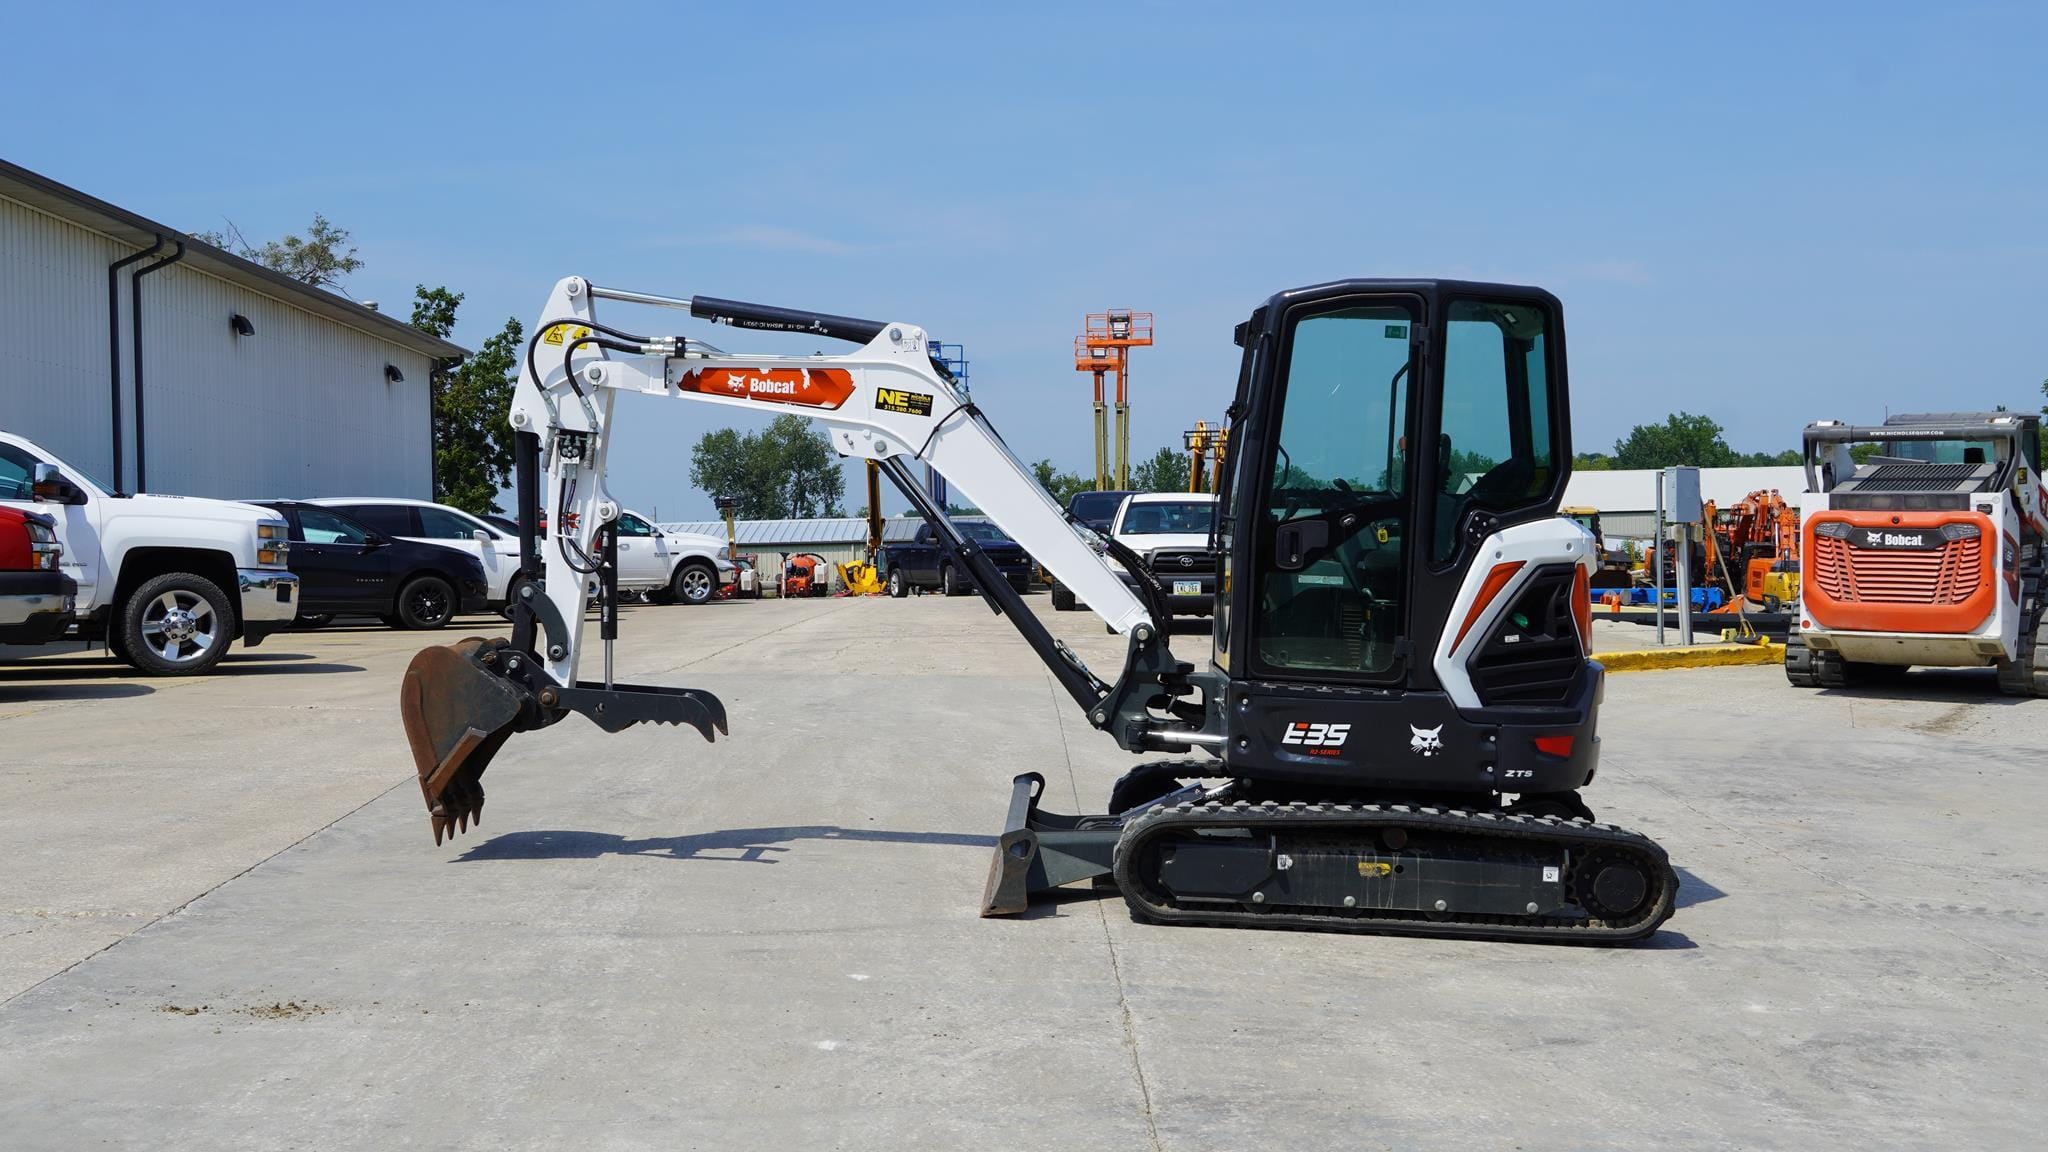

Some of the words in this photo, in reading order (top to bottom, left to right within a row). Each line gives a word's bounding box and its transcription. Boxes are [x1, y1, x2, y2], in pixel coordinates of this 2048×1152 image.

[750, 377, 795, 394] Bobcat
[878, 389, 910, 407] NE
[1884, 533, 1922, 546] Bobcat
[1282, 722, 1352, 746] E35
[1505, 769, 1533, 778] ZTS
